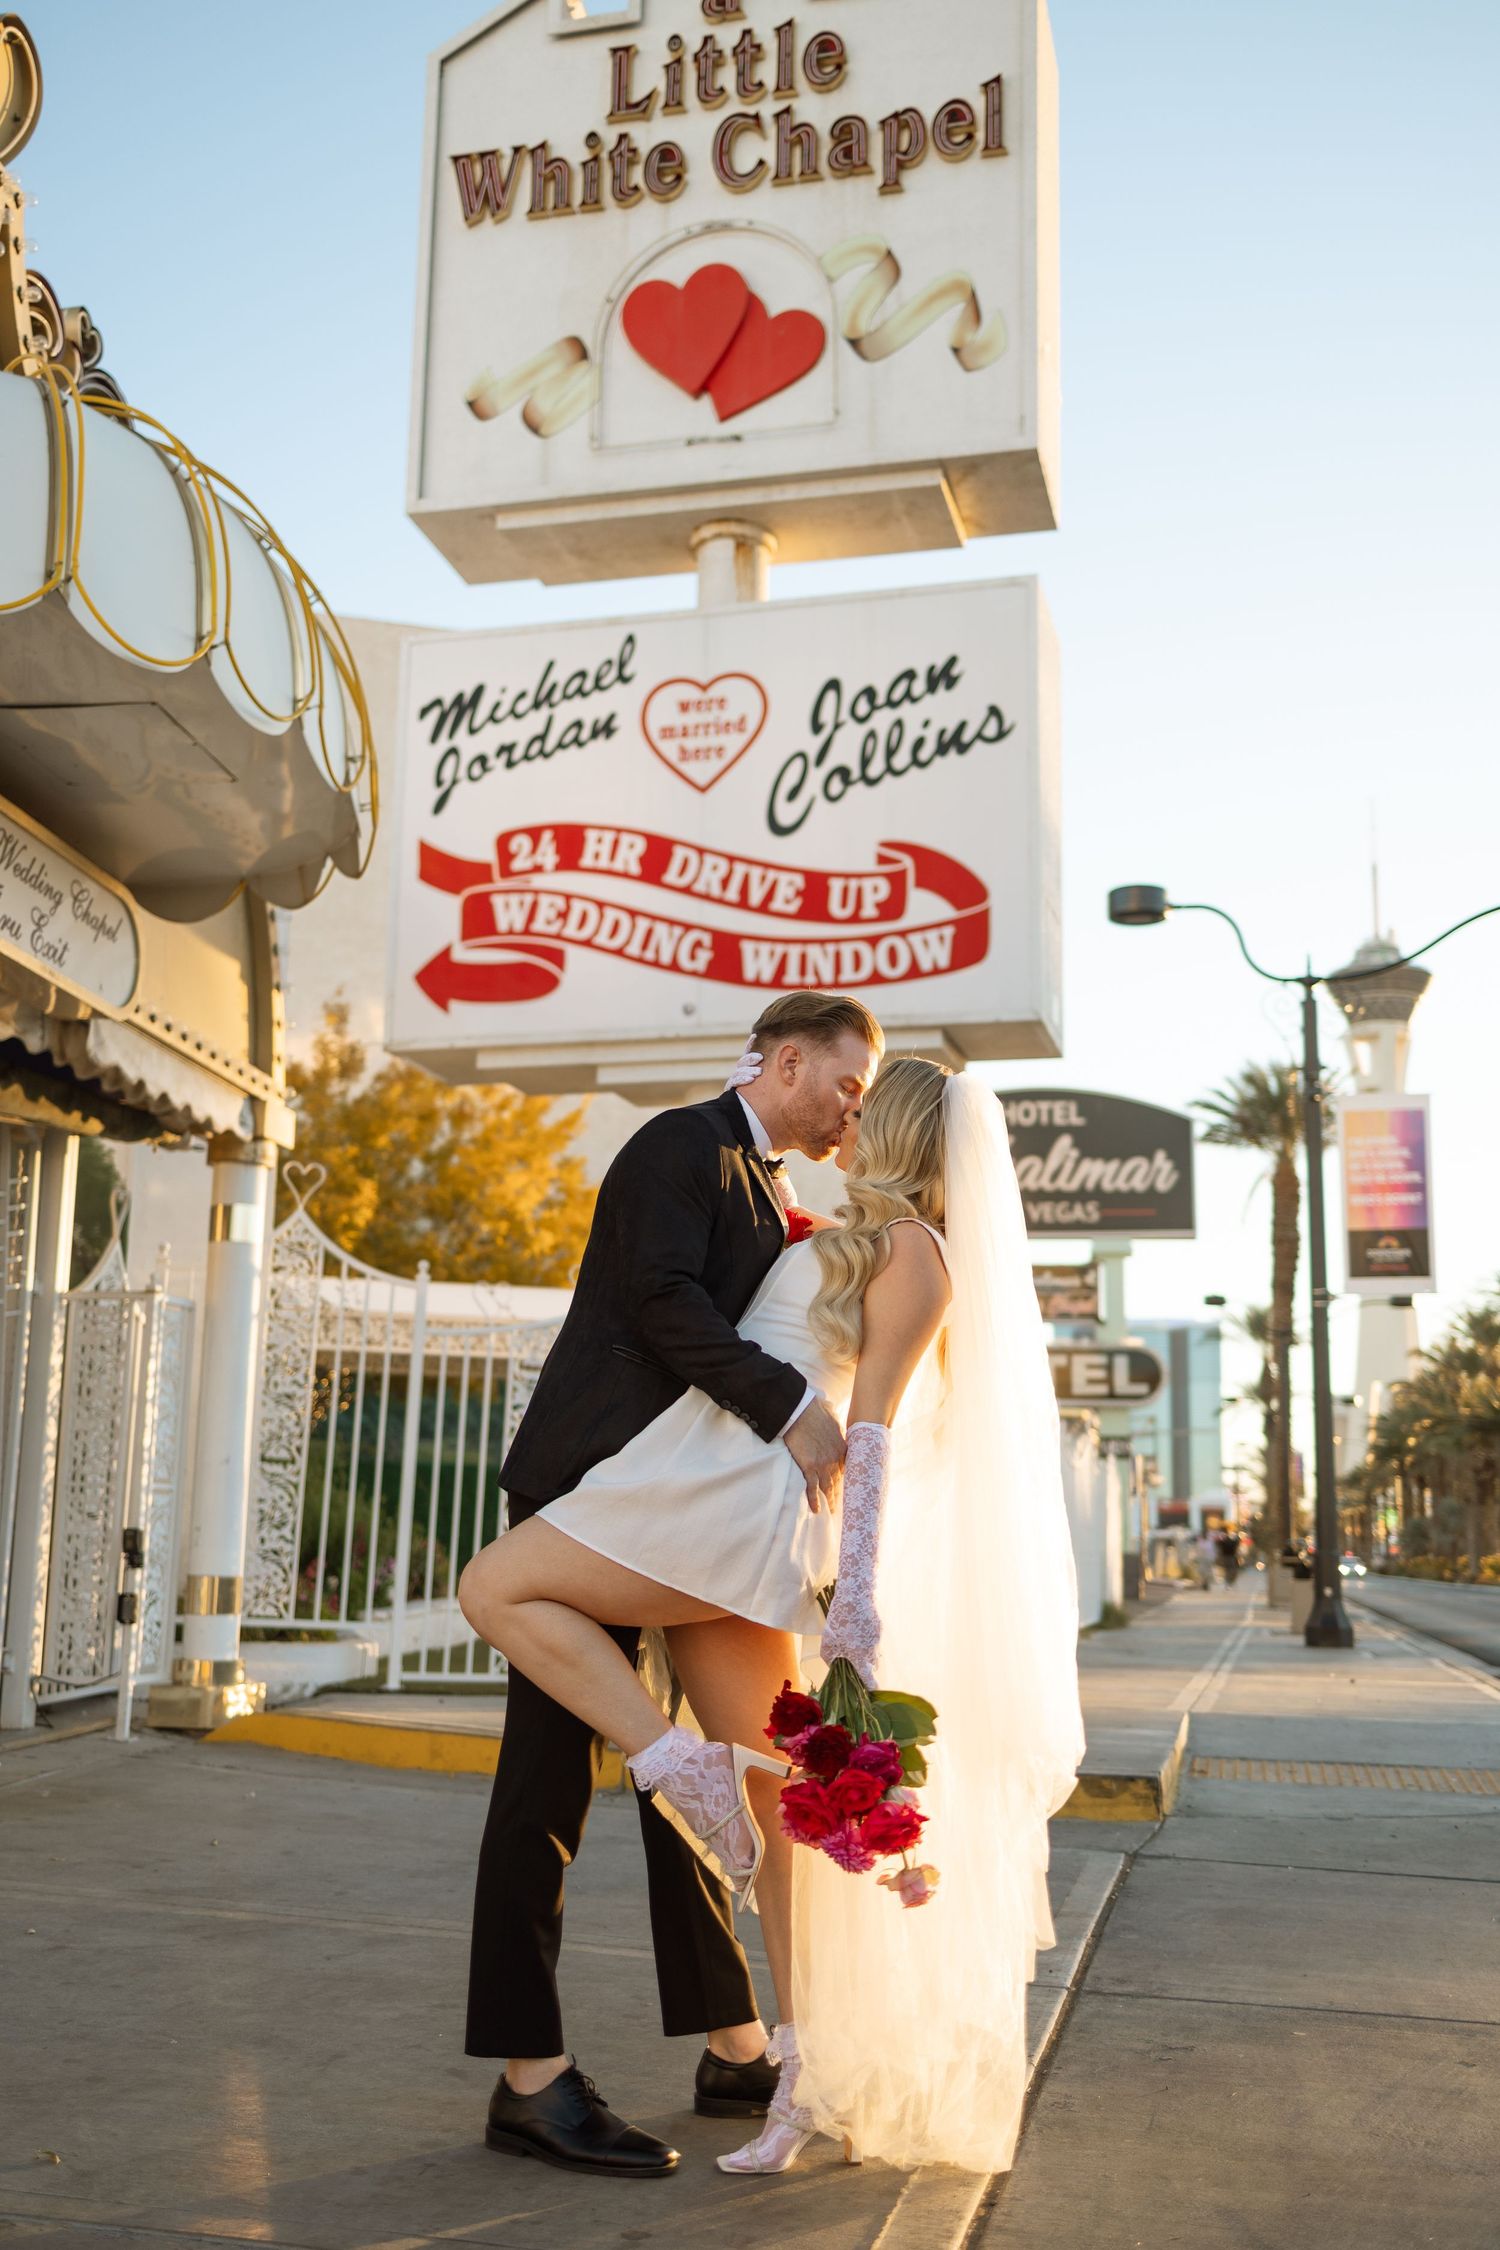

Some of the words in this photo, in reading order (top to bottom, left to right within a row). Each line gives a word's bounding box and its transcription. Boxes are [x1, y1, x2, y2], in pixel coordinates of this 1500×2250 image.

[607, 18, 848, 123] Little
[450, 131, 687, 227] White
[711, 73, 1008, 194] Chapel
[418, 633, 638, 744] Michael
[659, 714, 746, 740] married
[678, 697, 727, 713] were
[810, 654, 964, 768] Joan
[432, 712, 619, 816] Jordan
[678, 744, 724, 762] here
[766, 704, 1016, 837] Collins
[0, 827, 64, 916] Wedding
[70, 878, 123, 943] Chapel
[508, 833, 560, 872] 24
[578, 828, 649, 875] HR
[661, 844, 805, 917] DRIVE
[826, 875, 892, 918] UP
[30, 905, 69, 968] Exit
[490, 893, 714, 972] WEDDING
[740, 925, 957, 985] WINDOW
[1025, 1201, 1100, 1224] VEGAS
